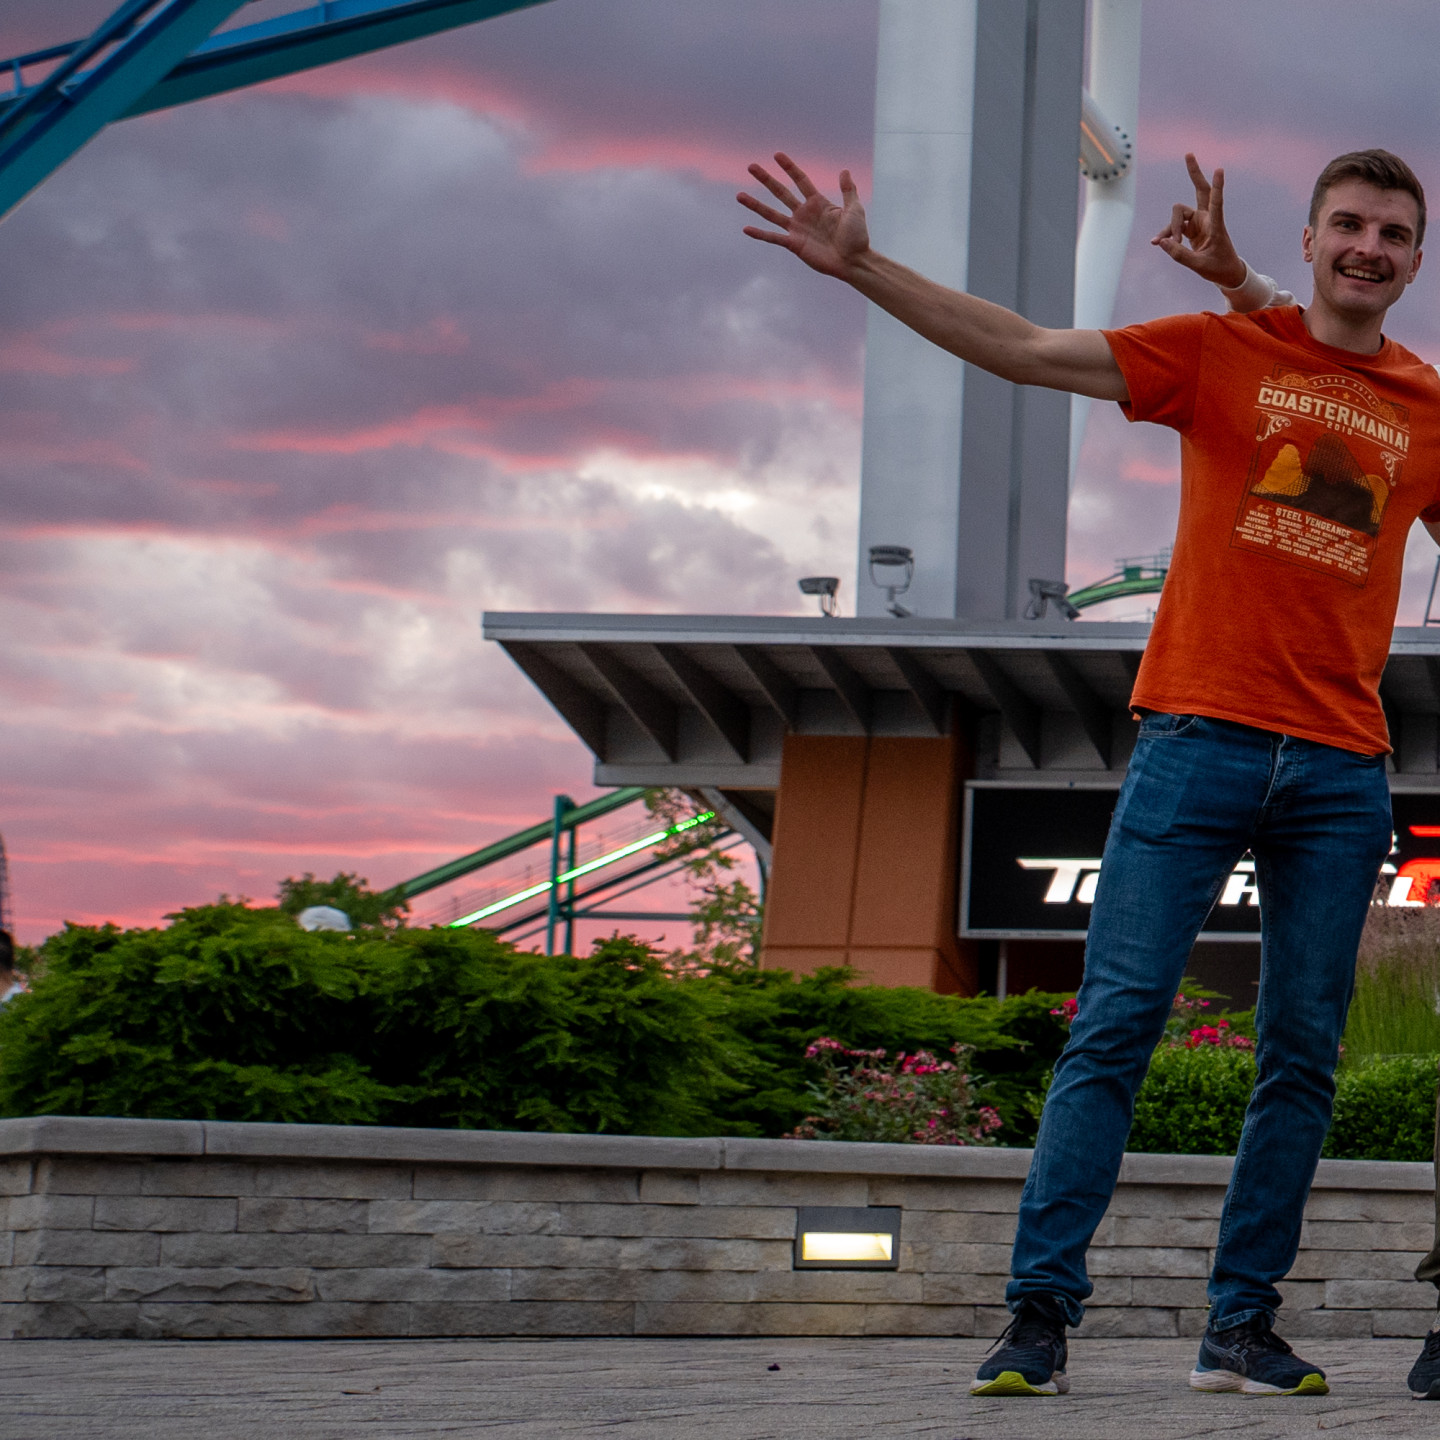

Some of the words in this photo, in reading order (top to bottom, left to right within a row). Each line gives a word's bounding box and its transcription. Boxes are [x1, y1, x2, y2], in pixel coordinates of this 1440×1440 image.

[1258, 387, 1410, 453] COASTERMANIA!
[1275, 507, 1303, 523] STEEL
[1305, 515, 1352, 539] VENGEANCE
